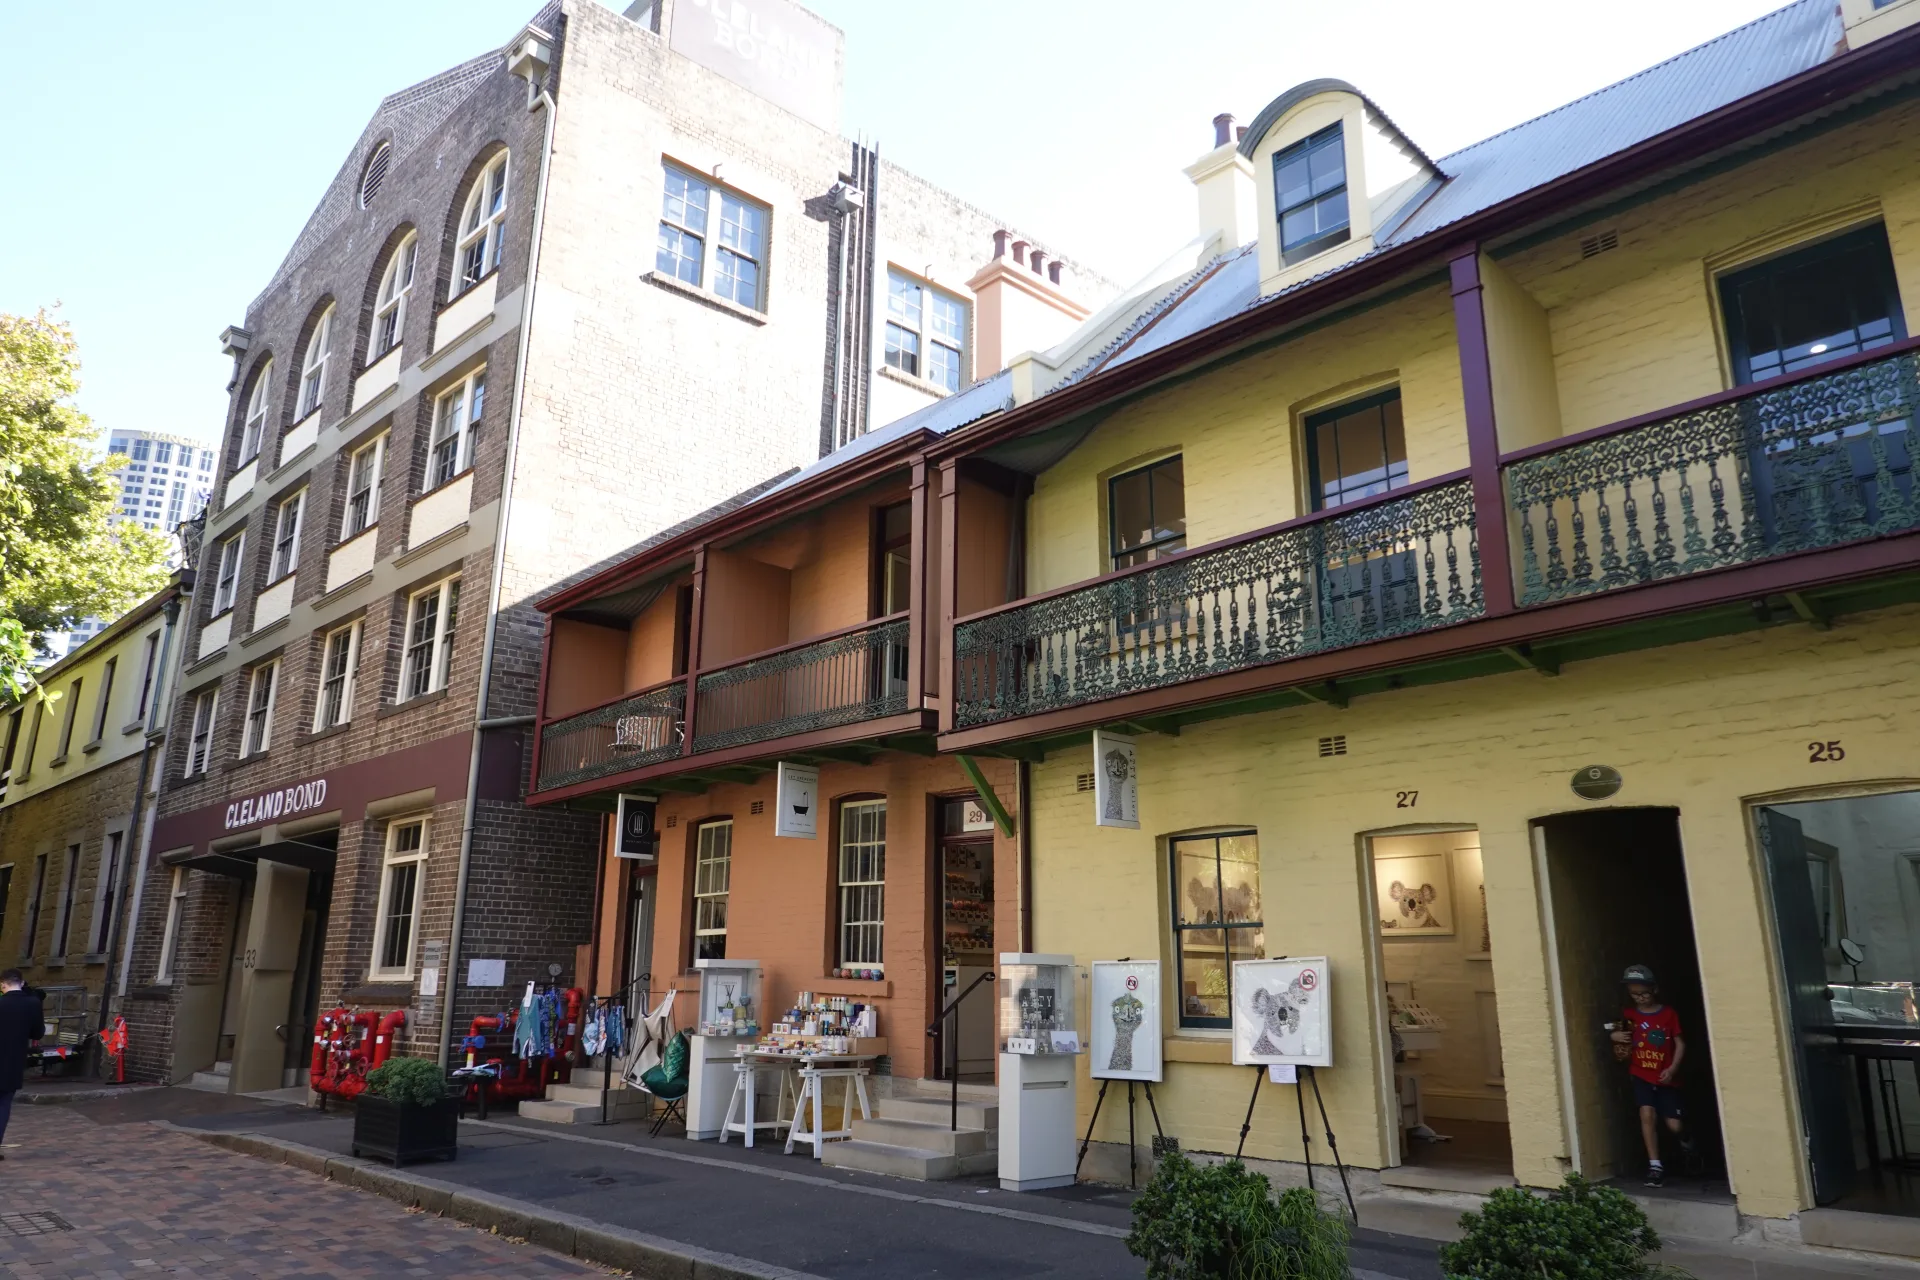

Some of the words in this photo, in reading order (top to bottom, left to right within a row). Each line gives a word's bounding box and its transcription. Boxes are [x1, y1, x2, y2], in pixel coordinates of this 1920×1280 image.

[693, 0, 822, 68] LELAND
[1808, 740, 1845, 763] 25
[225, 791, 283, 829] CLELAND
[282, 779, 327, 815] BOND
[1396, 790, 1419, 808] 27
[969, 810, 983, 823] 29
[244, 949, 256, 968] 33
[1022, 996, 1053, 1008] ATY
[1635, 1049, 1665, 1061] LUCKY
[1641, 1060, 1658, 1069] DAY
